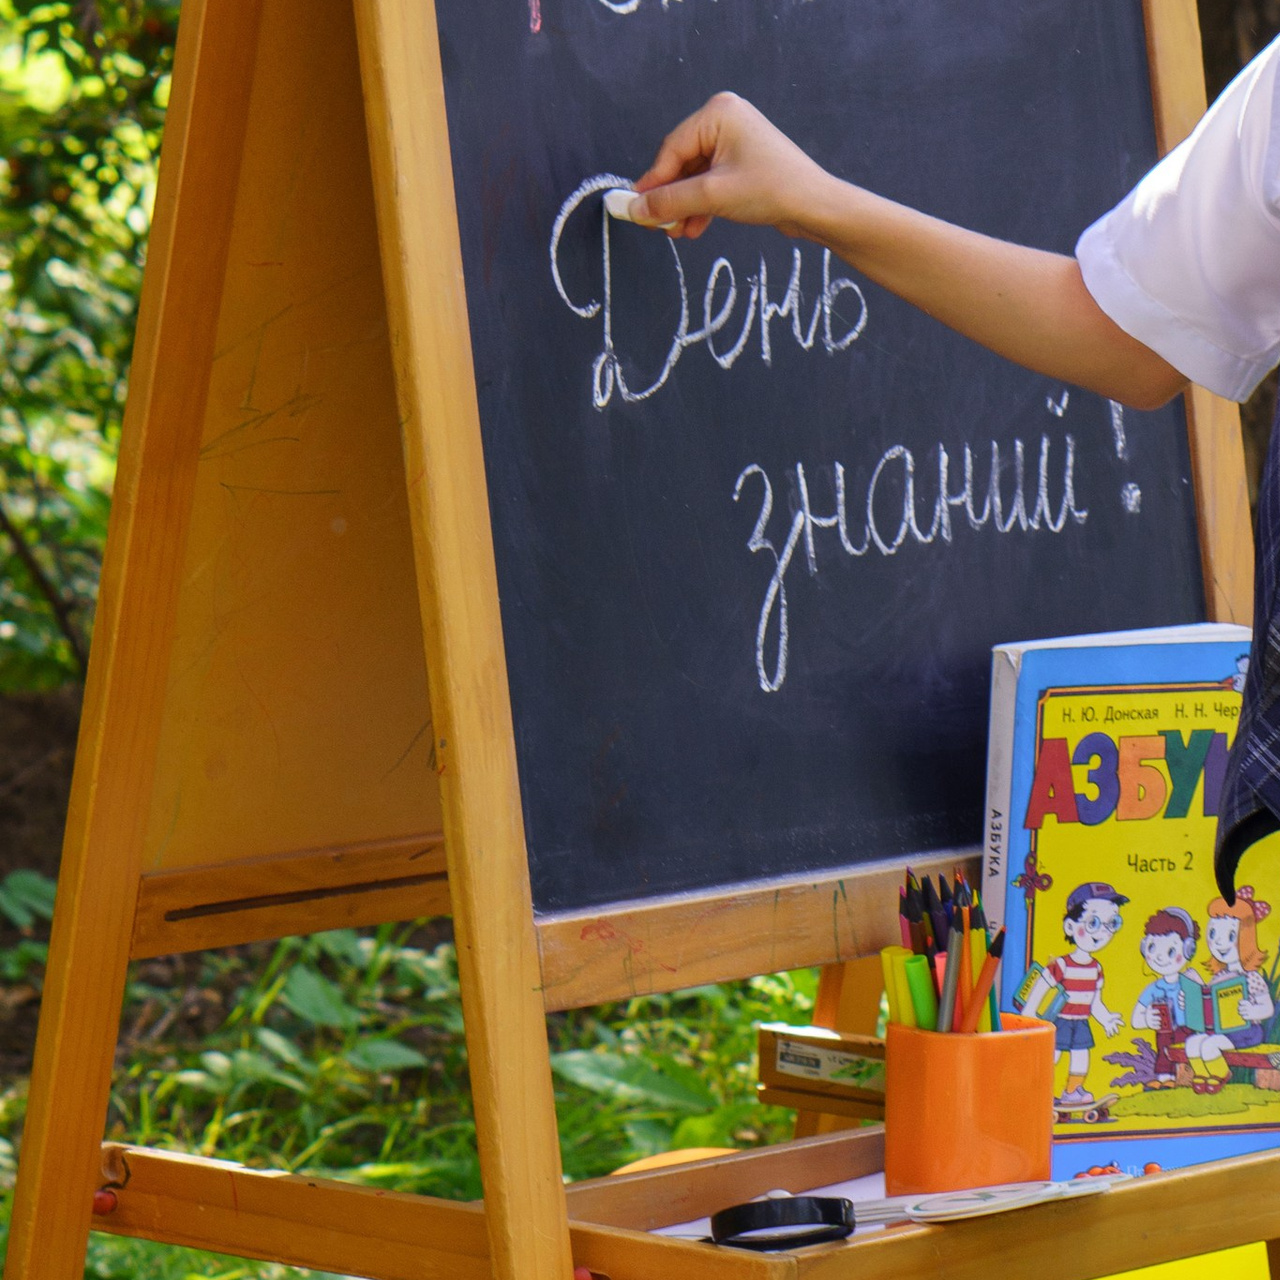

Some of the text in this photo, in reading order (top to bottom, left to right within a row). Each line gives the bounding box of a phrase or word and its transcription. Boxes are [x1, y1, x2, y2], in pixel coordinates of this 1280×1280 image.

[550, 172, 868, 411] День
[1062, 702, 1242, 724] Н. Ю. Донская Н. Н. Чер
[988, 808, 1003, 878] АЗБУКА
[1127, 850, 1194, 873] Часть 2
